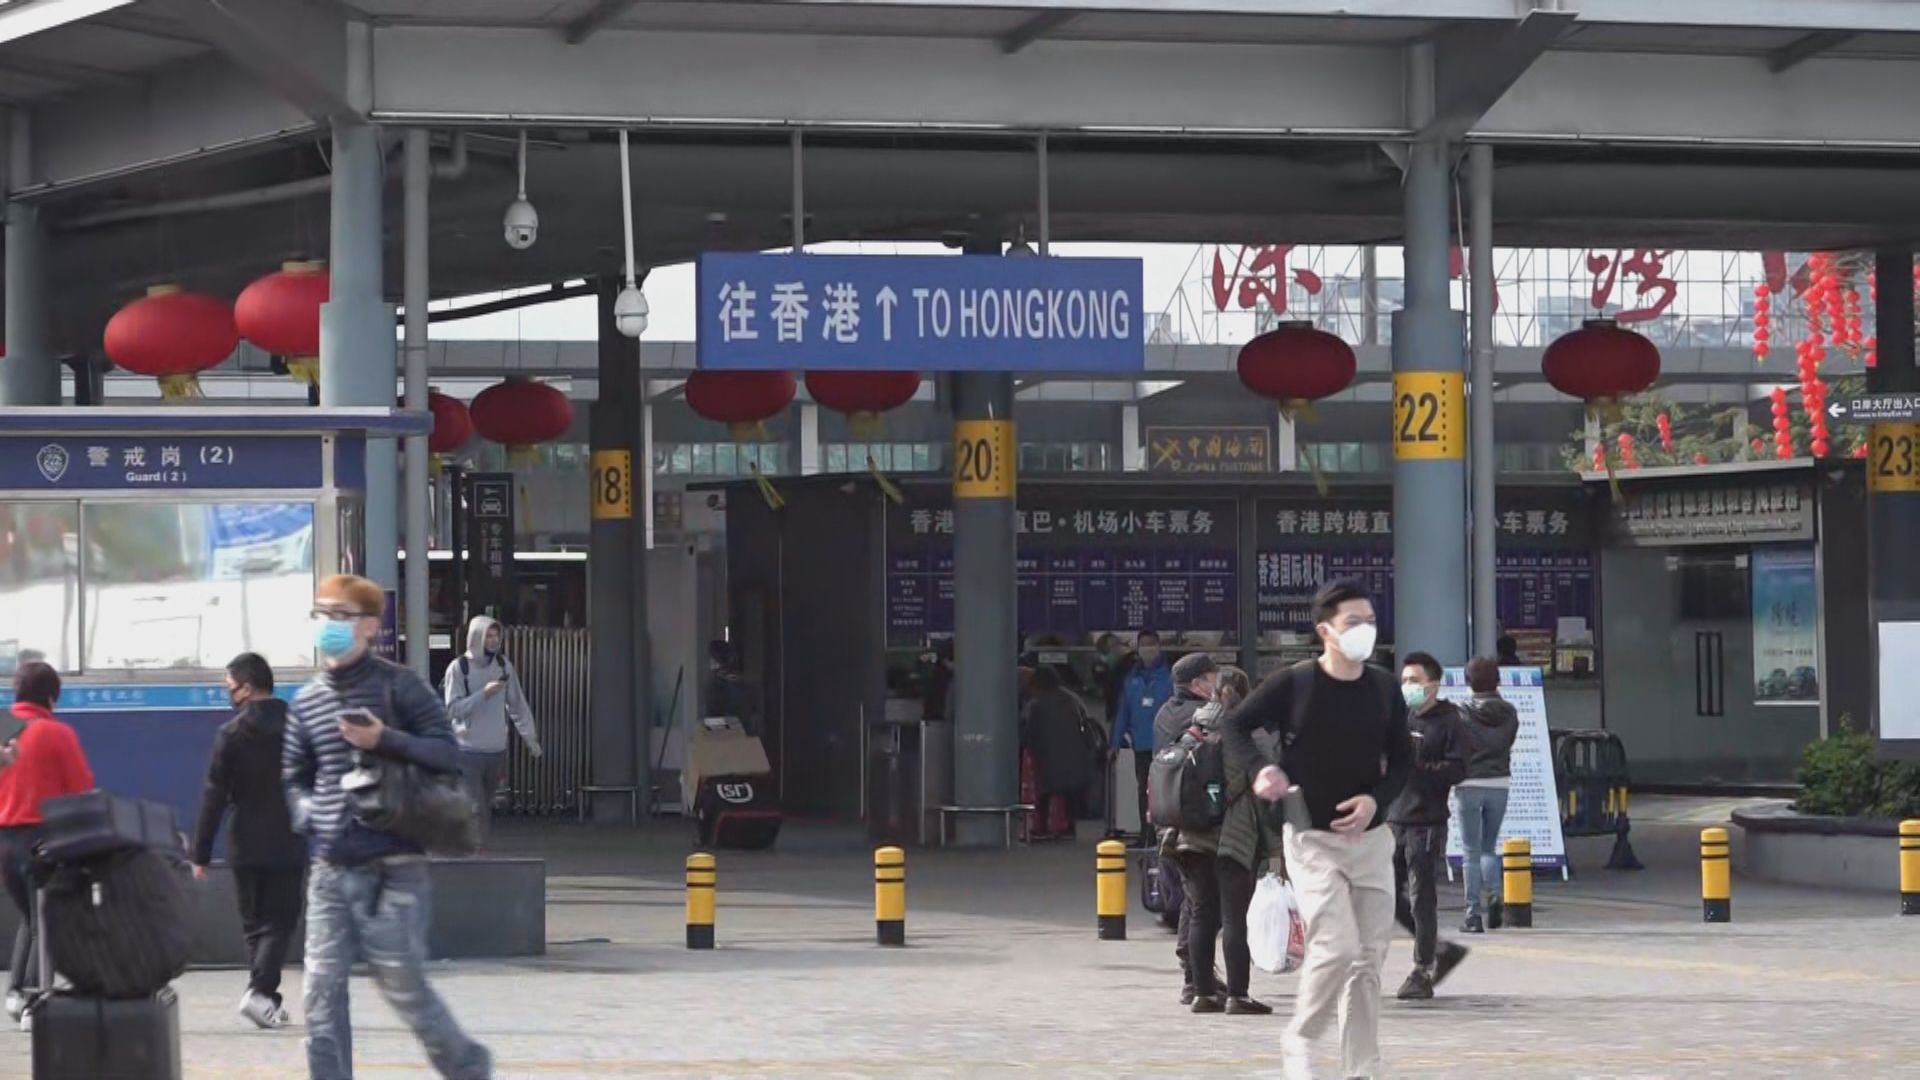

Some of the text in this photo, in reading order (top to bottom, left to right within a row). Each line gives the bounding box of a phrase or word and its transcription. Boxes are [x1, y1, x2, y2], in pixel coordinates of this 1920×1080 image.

[718, 281, 1130, 343] 往香港 TO HONGKONG
[1402, 392, 1438, 441] 22
[958, 438, 992, 481] 20
[1878, 435, 1912, 476] 23
[594, 467, 622, 504] 18
